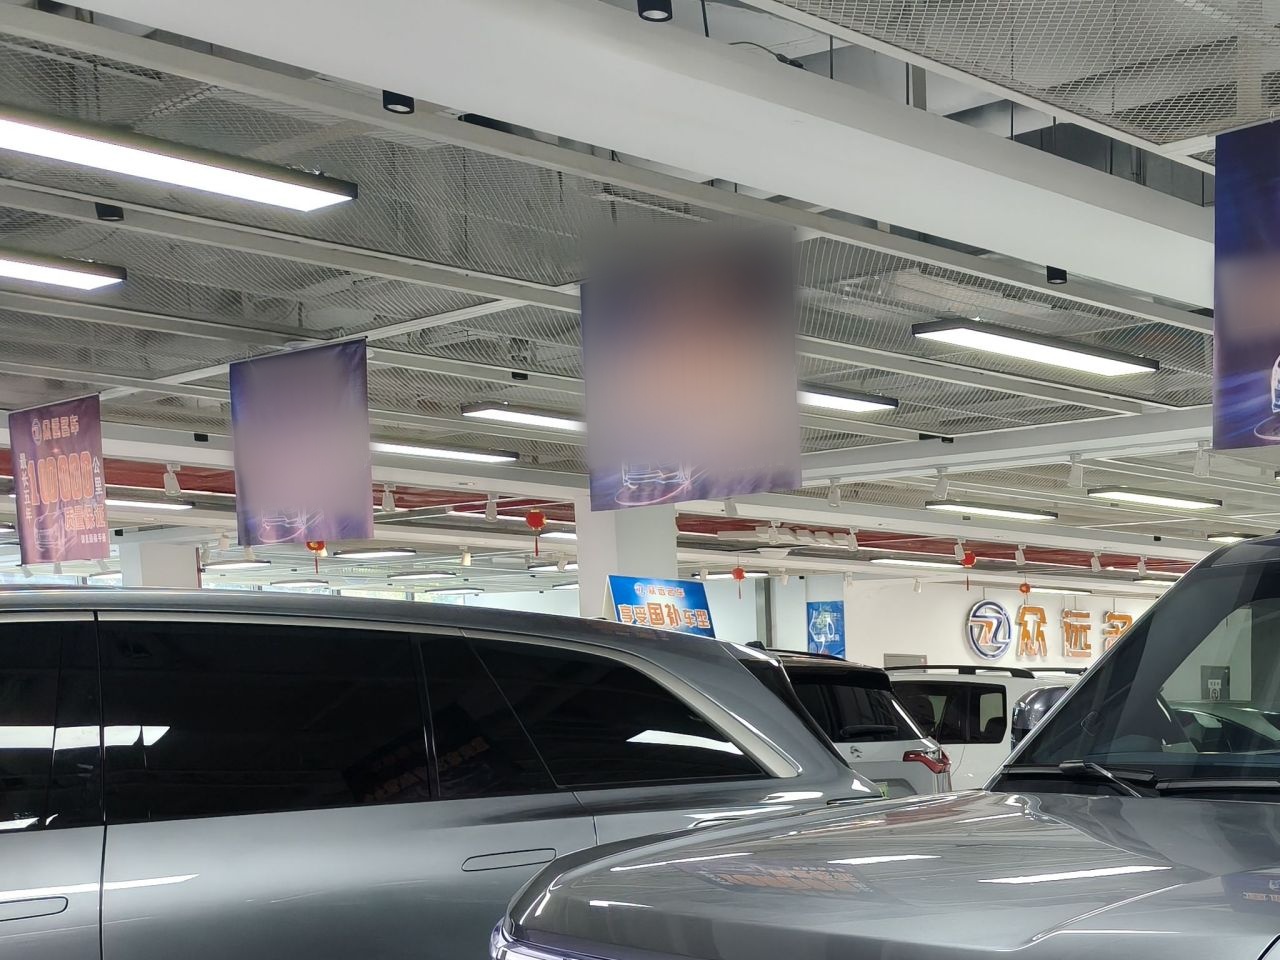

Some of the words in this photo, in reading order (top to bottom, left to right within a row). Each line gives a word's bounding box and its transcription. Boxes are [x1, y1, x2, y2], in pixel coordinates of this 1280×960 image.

[618, 602, 711, 629] 享受国补车型
